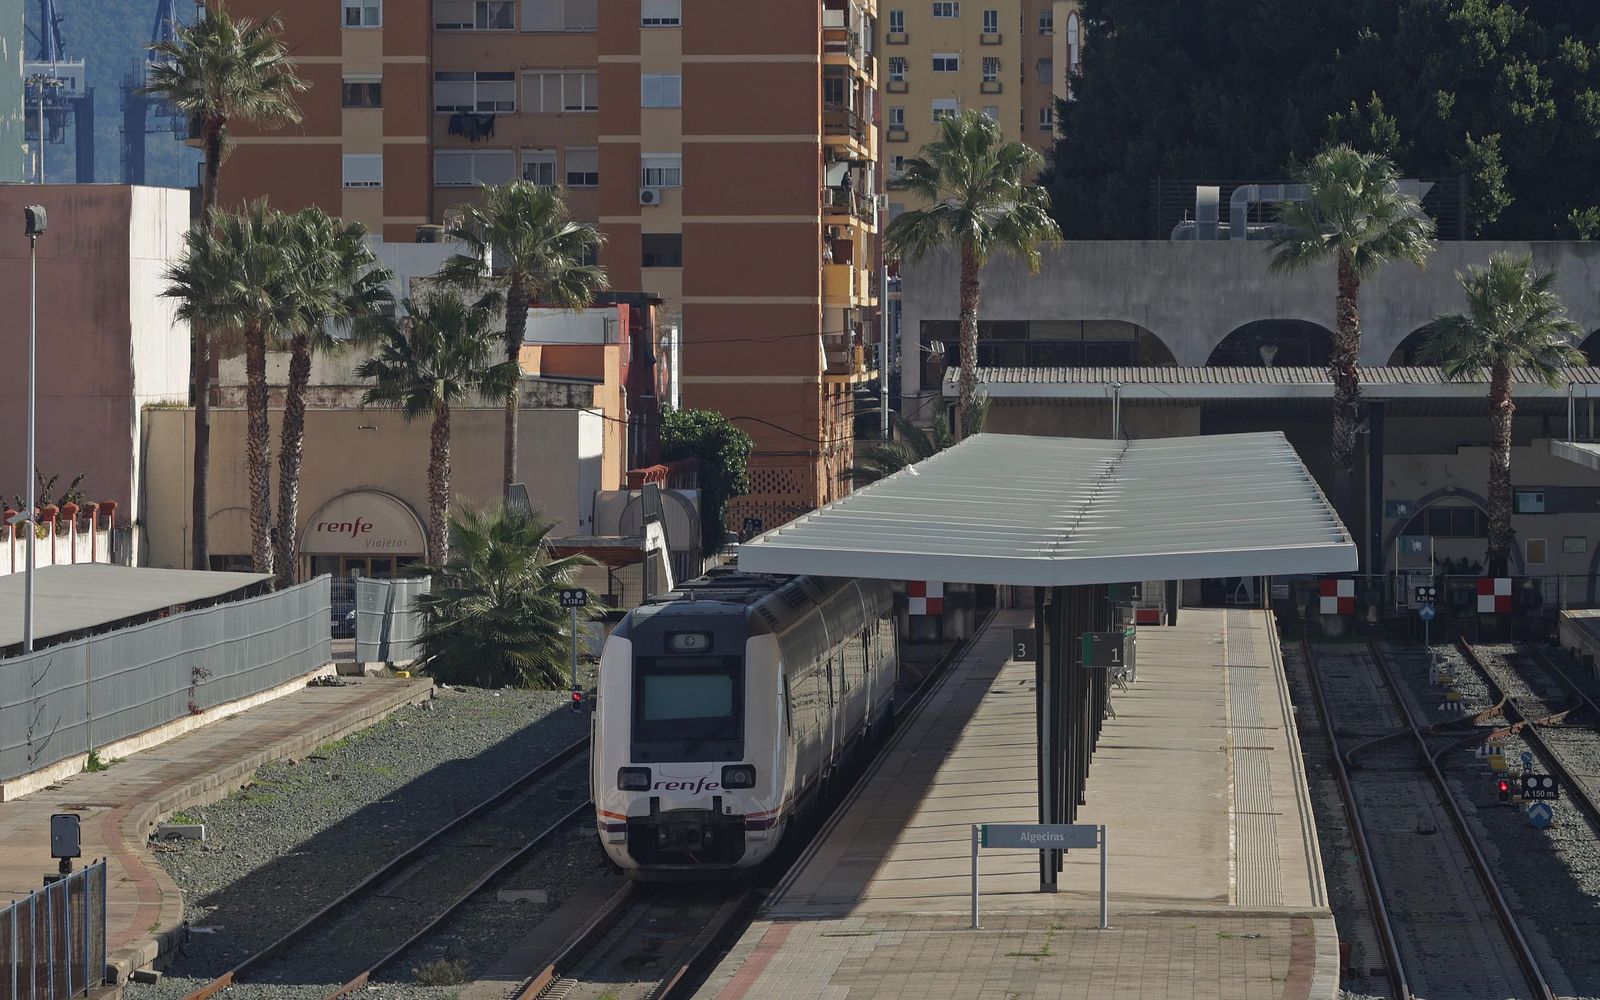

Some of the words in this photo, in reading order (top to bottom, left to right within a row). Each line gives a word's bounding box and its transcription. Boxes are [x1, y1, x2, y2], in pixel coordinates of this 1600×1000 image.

[317, 517, 373, 538] renfe
[365, 539, 408, 548] Viajeros
[1132, 585, 1139, 598] 1
[1017, 643, 1026, 658] 3
[1111, 647, 1120, 662] 1
[653, 776, 719, 795] renfe
[1524, 790, 1530, 798] A
[1532, 790, 1545, 798] 150
[1020, 831, 1065, 843] Algeciras
